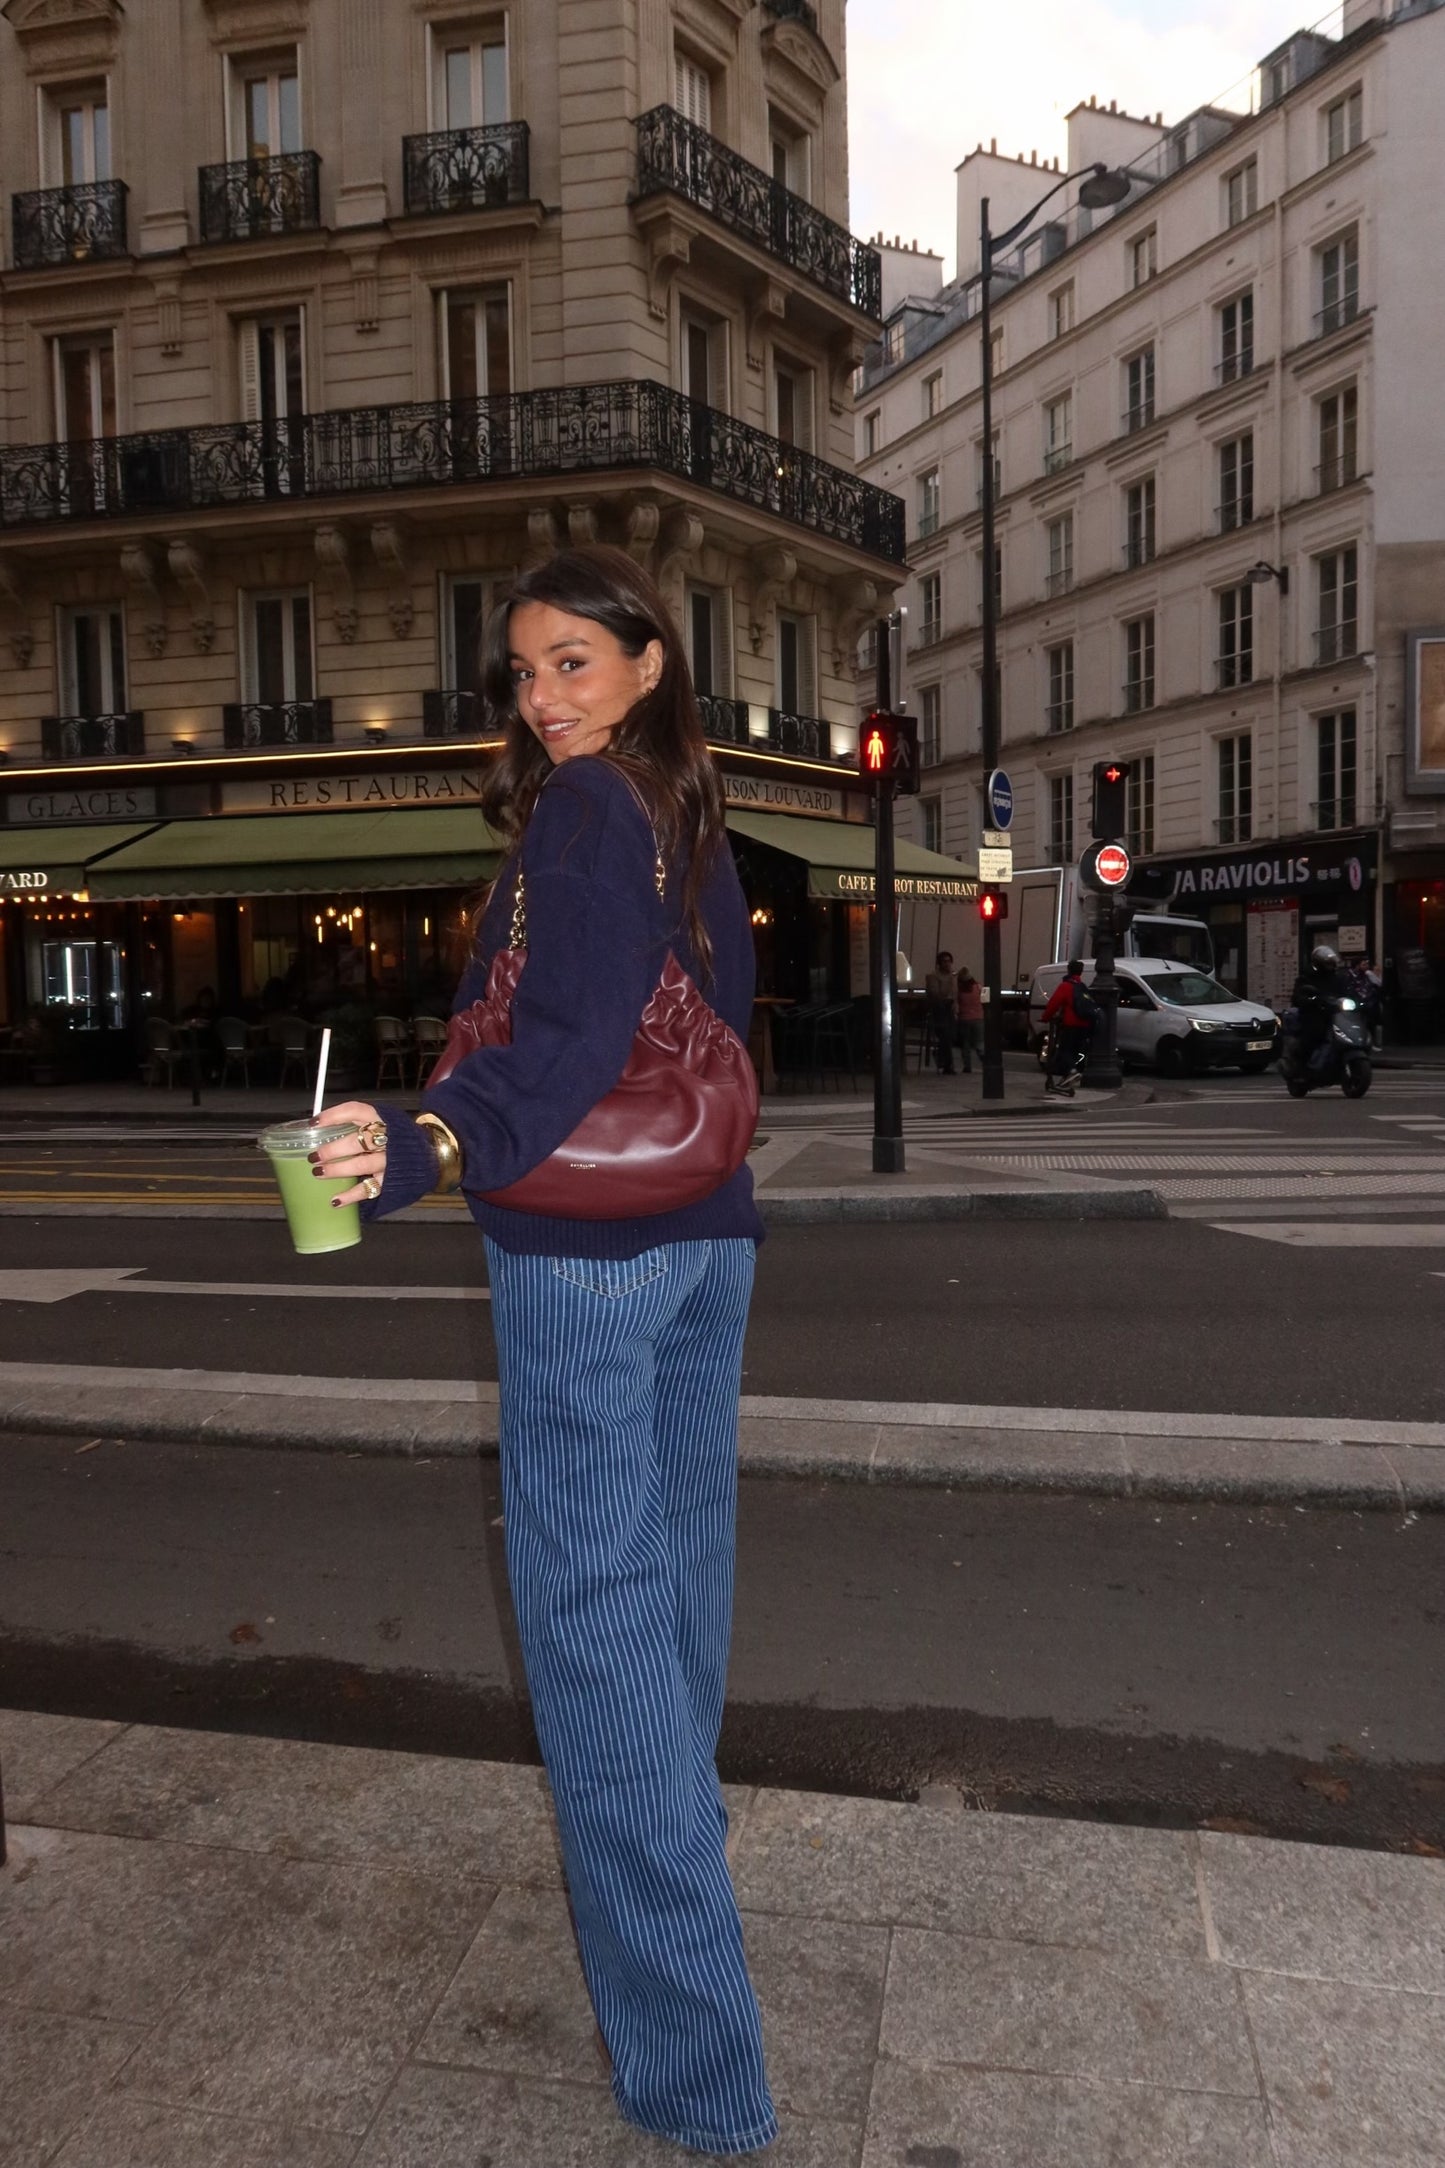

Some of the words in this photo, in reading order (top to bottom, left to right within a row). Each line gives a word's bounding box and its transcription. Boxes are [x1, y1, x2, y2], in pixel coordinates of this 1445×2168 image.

[27, 790, 137, 818] GLACES
[270, 773, 481, 806] RESTAURAN
[725, 778, 759, 801] ISON
[764, 784, 832, 811] LOUVARD
[838, 874, 868, 890] CAFE
[917, 880, 979, 897] RESTAURANT
[1200, 857, 1310, 892] RAVIOLIS
